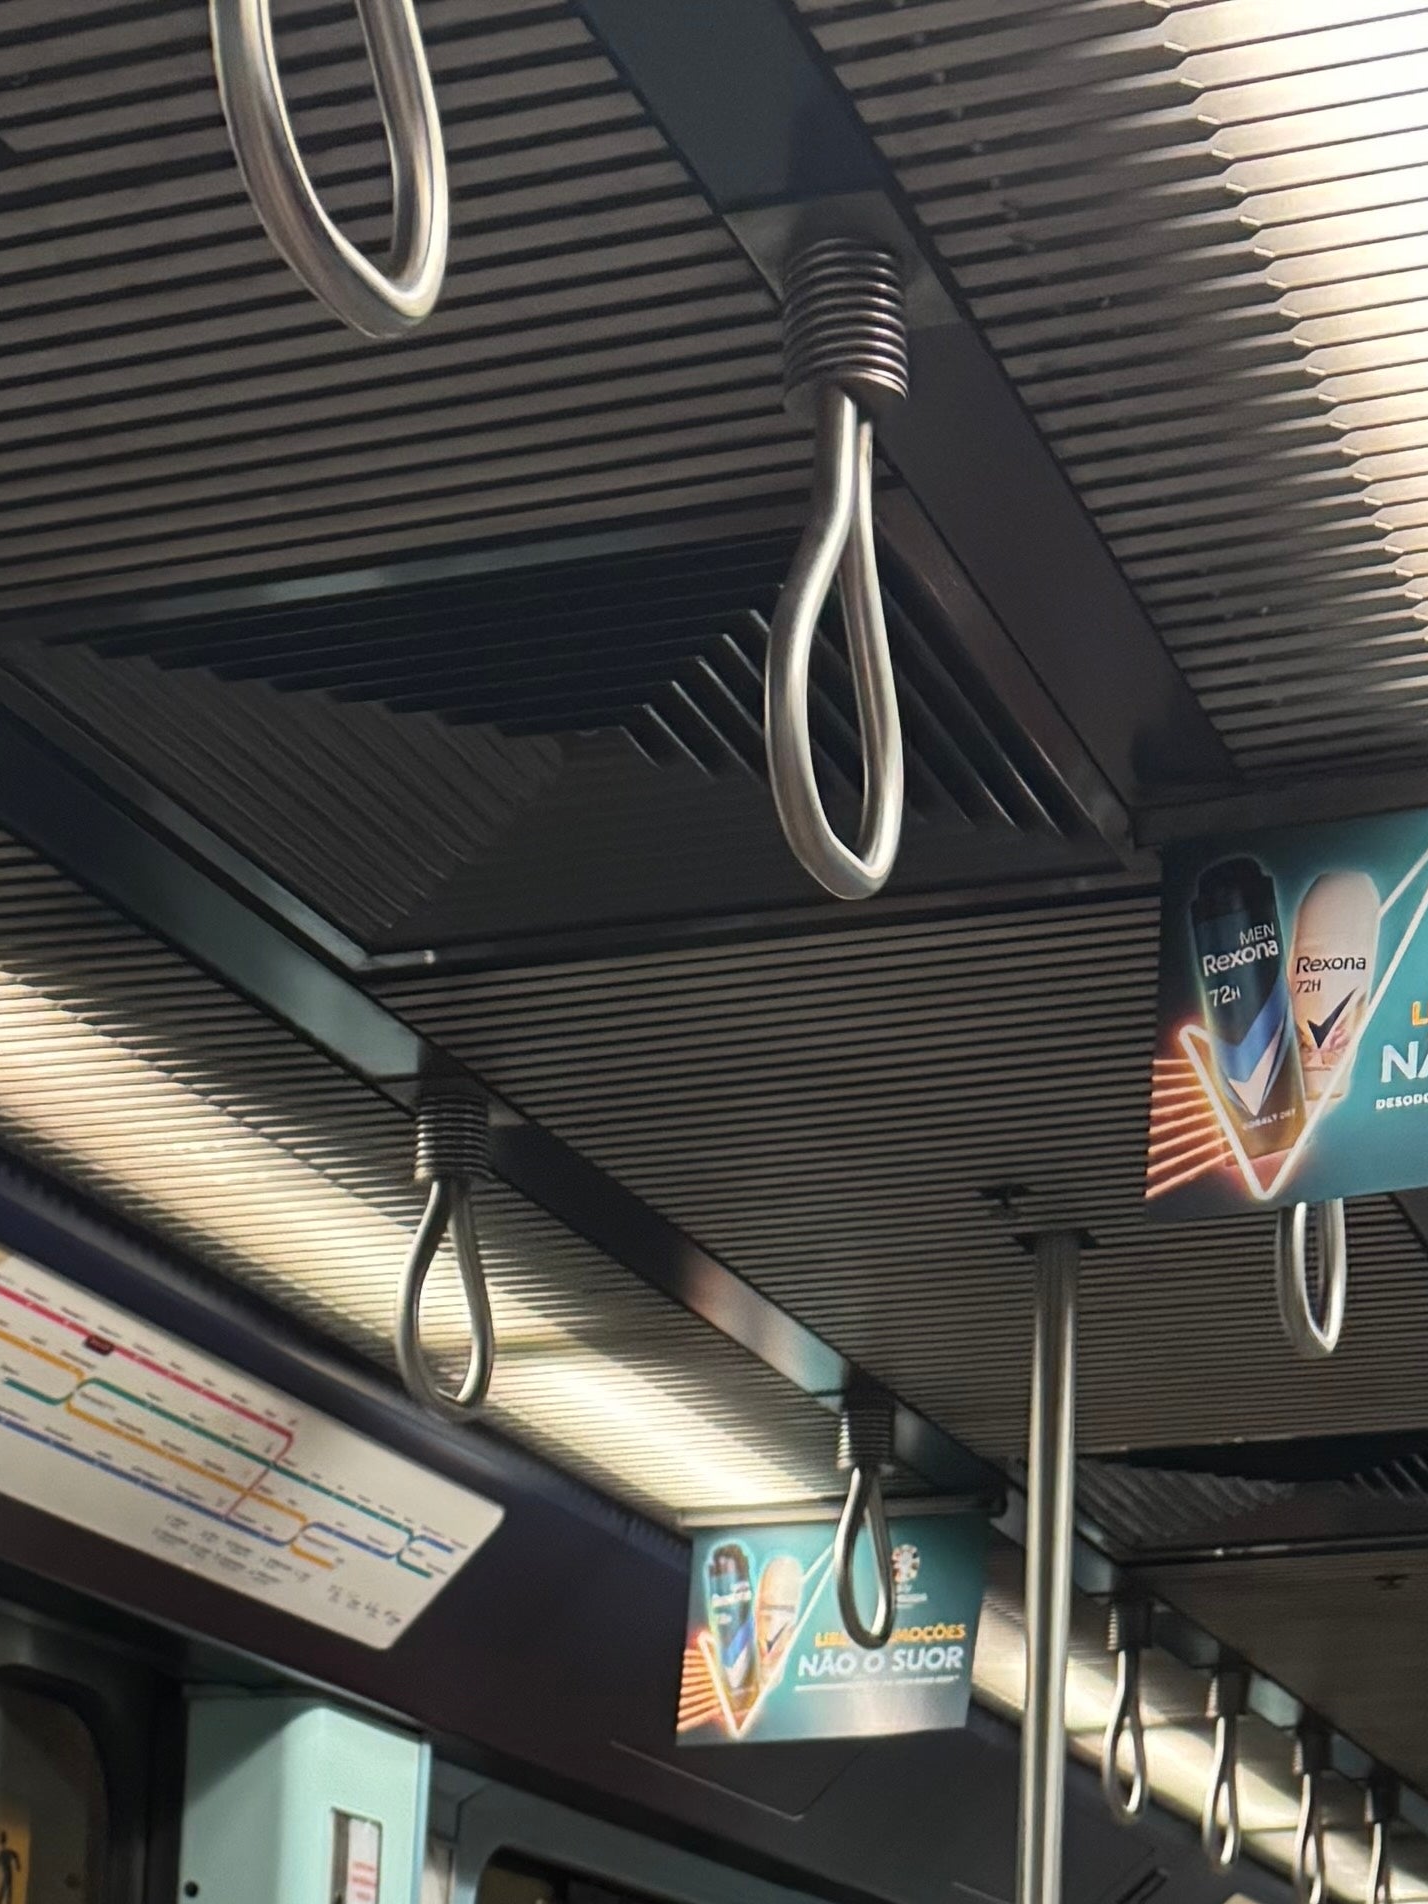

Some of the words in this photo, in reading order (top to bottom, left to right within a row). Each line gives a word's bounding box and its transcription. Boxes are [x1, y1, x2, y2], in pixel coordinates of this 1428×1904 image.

[1239, 923, 1276, 946] MEN
[1202, 939, 1279, 977] Rexona
[1295, 956, 1366, 975] Rexona
[1295, 980, 1322, 994] 72H
[798, 1650, 856, 1678] NÃO
[863, 1652, 886, 1674] O
[891, 1645, 964, 1672] SUOR
